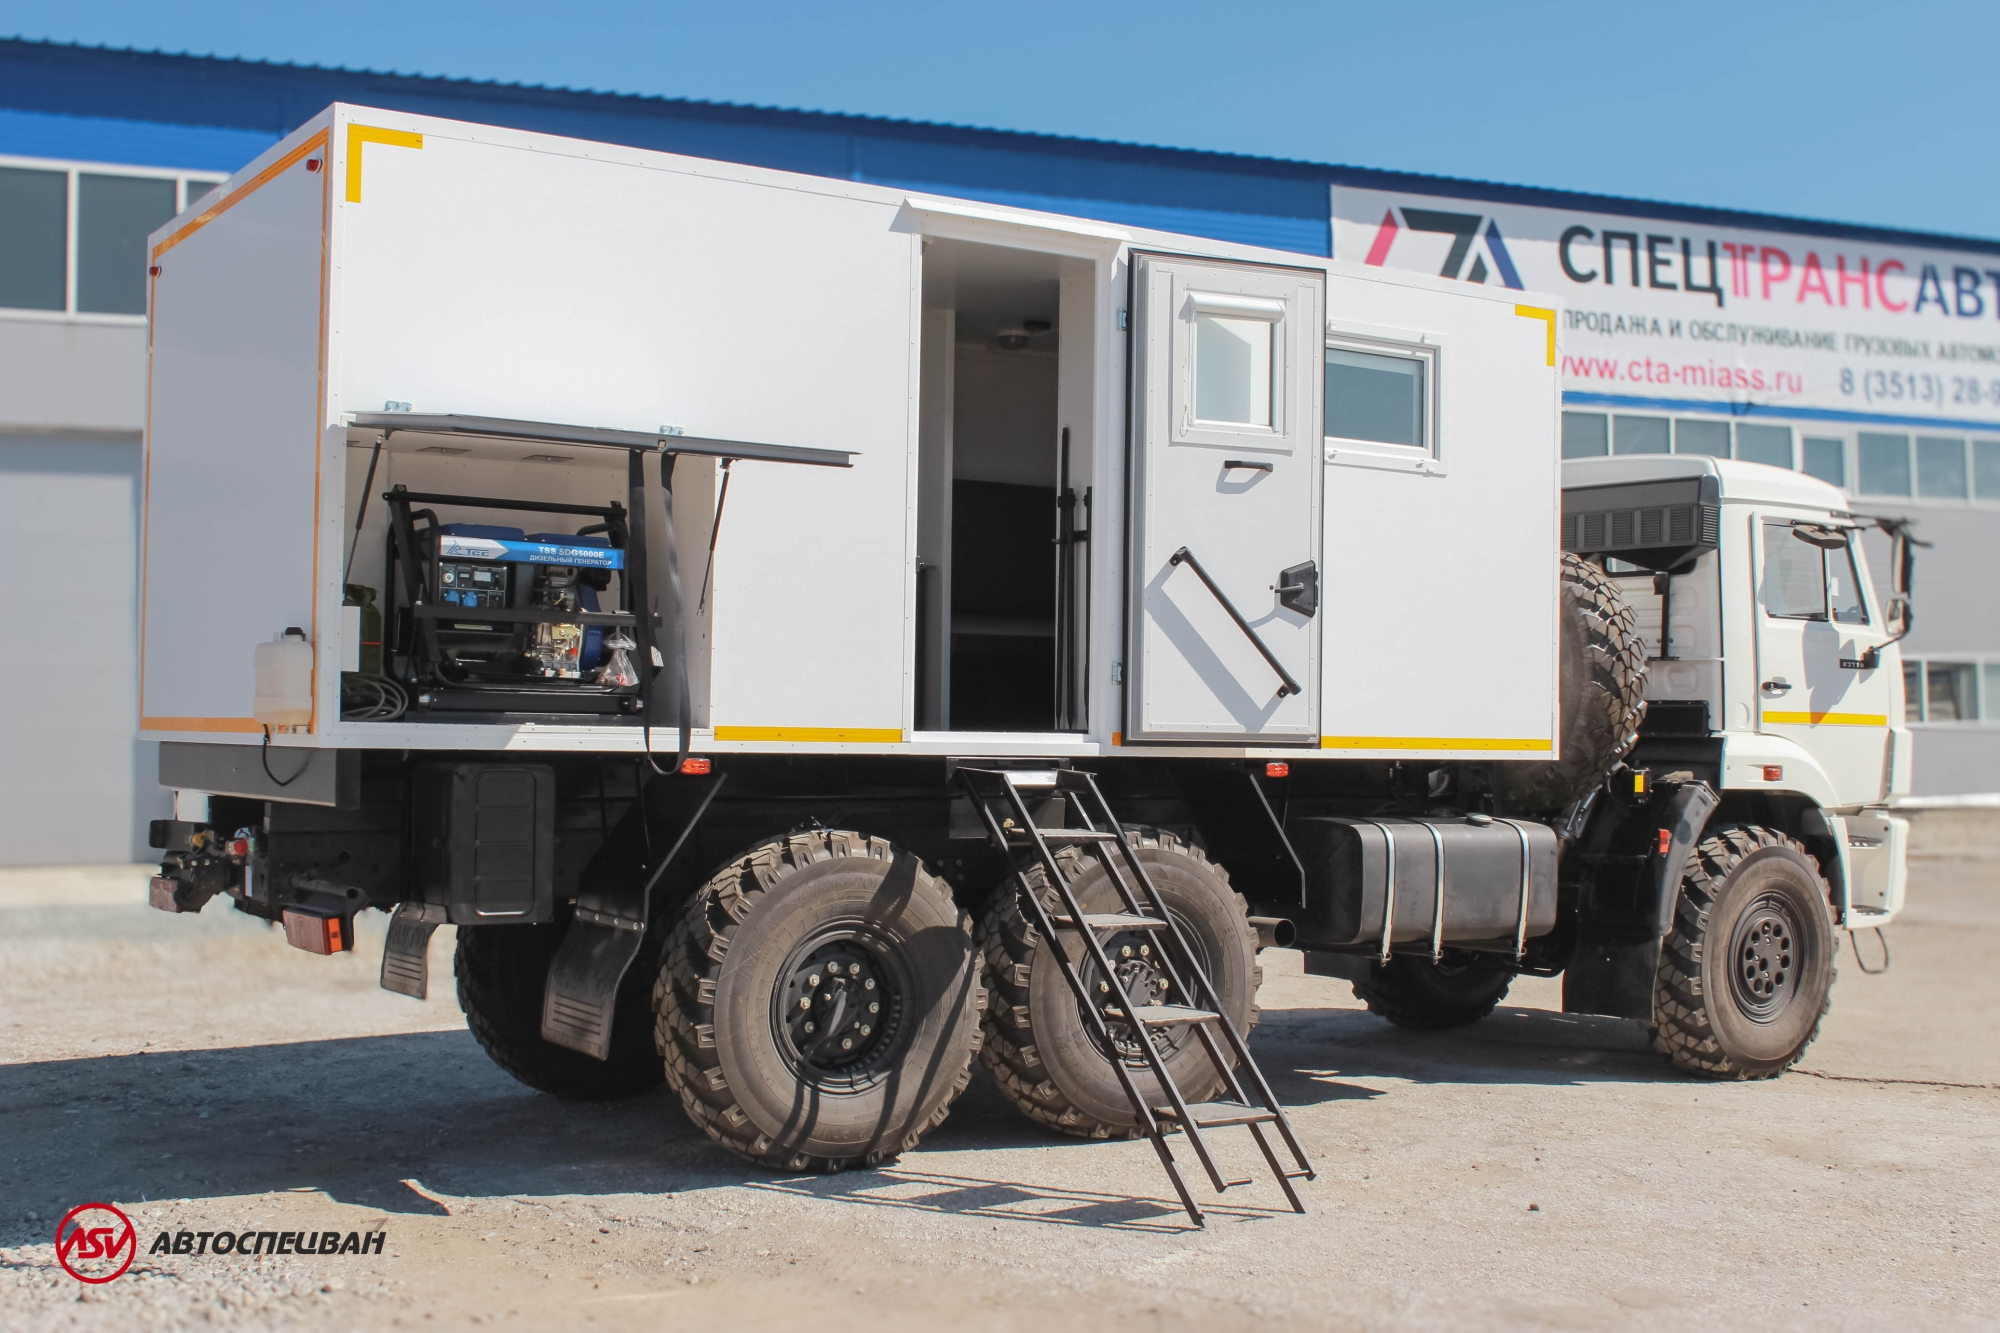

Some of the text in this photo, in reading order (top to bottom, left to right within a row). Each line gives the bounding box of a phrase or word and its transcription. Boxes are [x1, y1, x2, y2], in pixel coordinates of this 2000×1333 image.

[1563, 309, 1662, 337] ПРОДАЖА
[1669, 319, 1682, 338] И
[1689, 320, 1837, 351] ОБСЛУЖИВАНИЕ
[1844, 333, 1931, 360] ГРУЗОВЫХ
[1562, 355, 1803, 394] ww.cta-miass.ru
[1840, 367, 1854, 396] 8
[1865, 369, 1944, 408] (3513)
[529, 554, 613, 567] ДИЗЕЛЬНЫЙ ГЕНЕРАТОР
[538, 546, 605, 559] TSS SDG5000E
